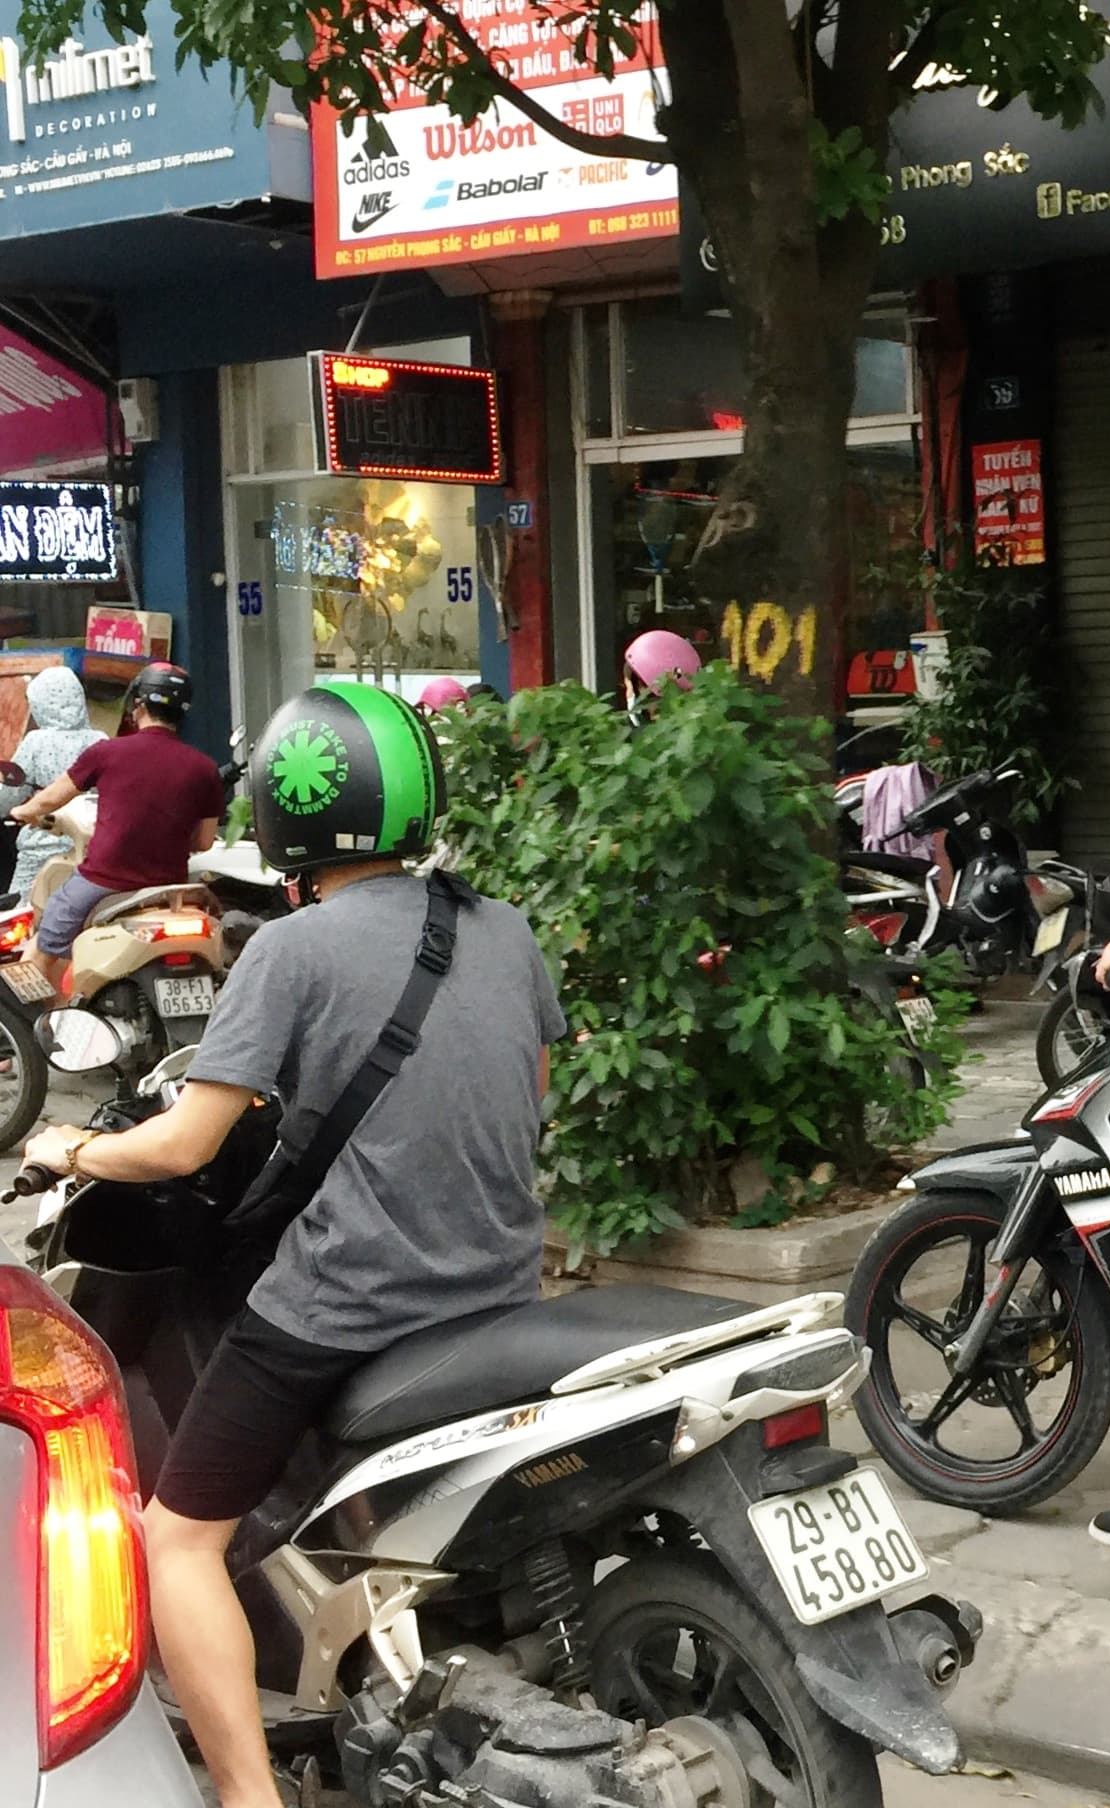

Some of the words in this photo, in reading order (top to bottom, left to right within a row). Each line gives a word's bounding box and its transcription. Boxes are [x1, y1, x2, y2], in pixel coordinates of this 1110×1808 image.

[34, 103, 157, 139] DECORATION
[422, 117, 538, 161] Wilson
[343, 159, 411, 186] adidas
[901, 160, 973, 191] Phong
[984, 141, 1030, 177] Sắc
[359, 190, 393, 216] NIKE
[508, 503, 529, 526] 57
[237, 581, 263, 617] 55
[447, 566, 473, 603] 55
[720, 599, 817, 686] 101
[335, 761, 349, 783] TO
[512, 1452, 590, 1489] YAMAHA
[773, 1479, 881, 1555] 29-B1
[792, 1528, 917, 1612] 458.80
